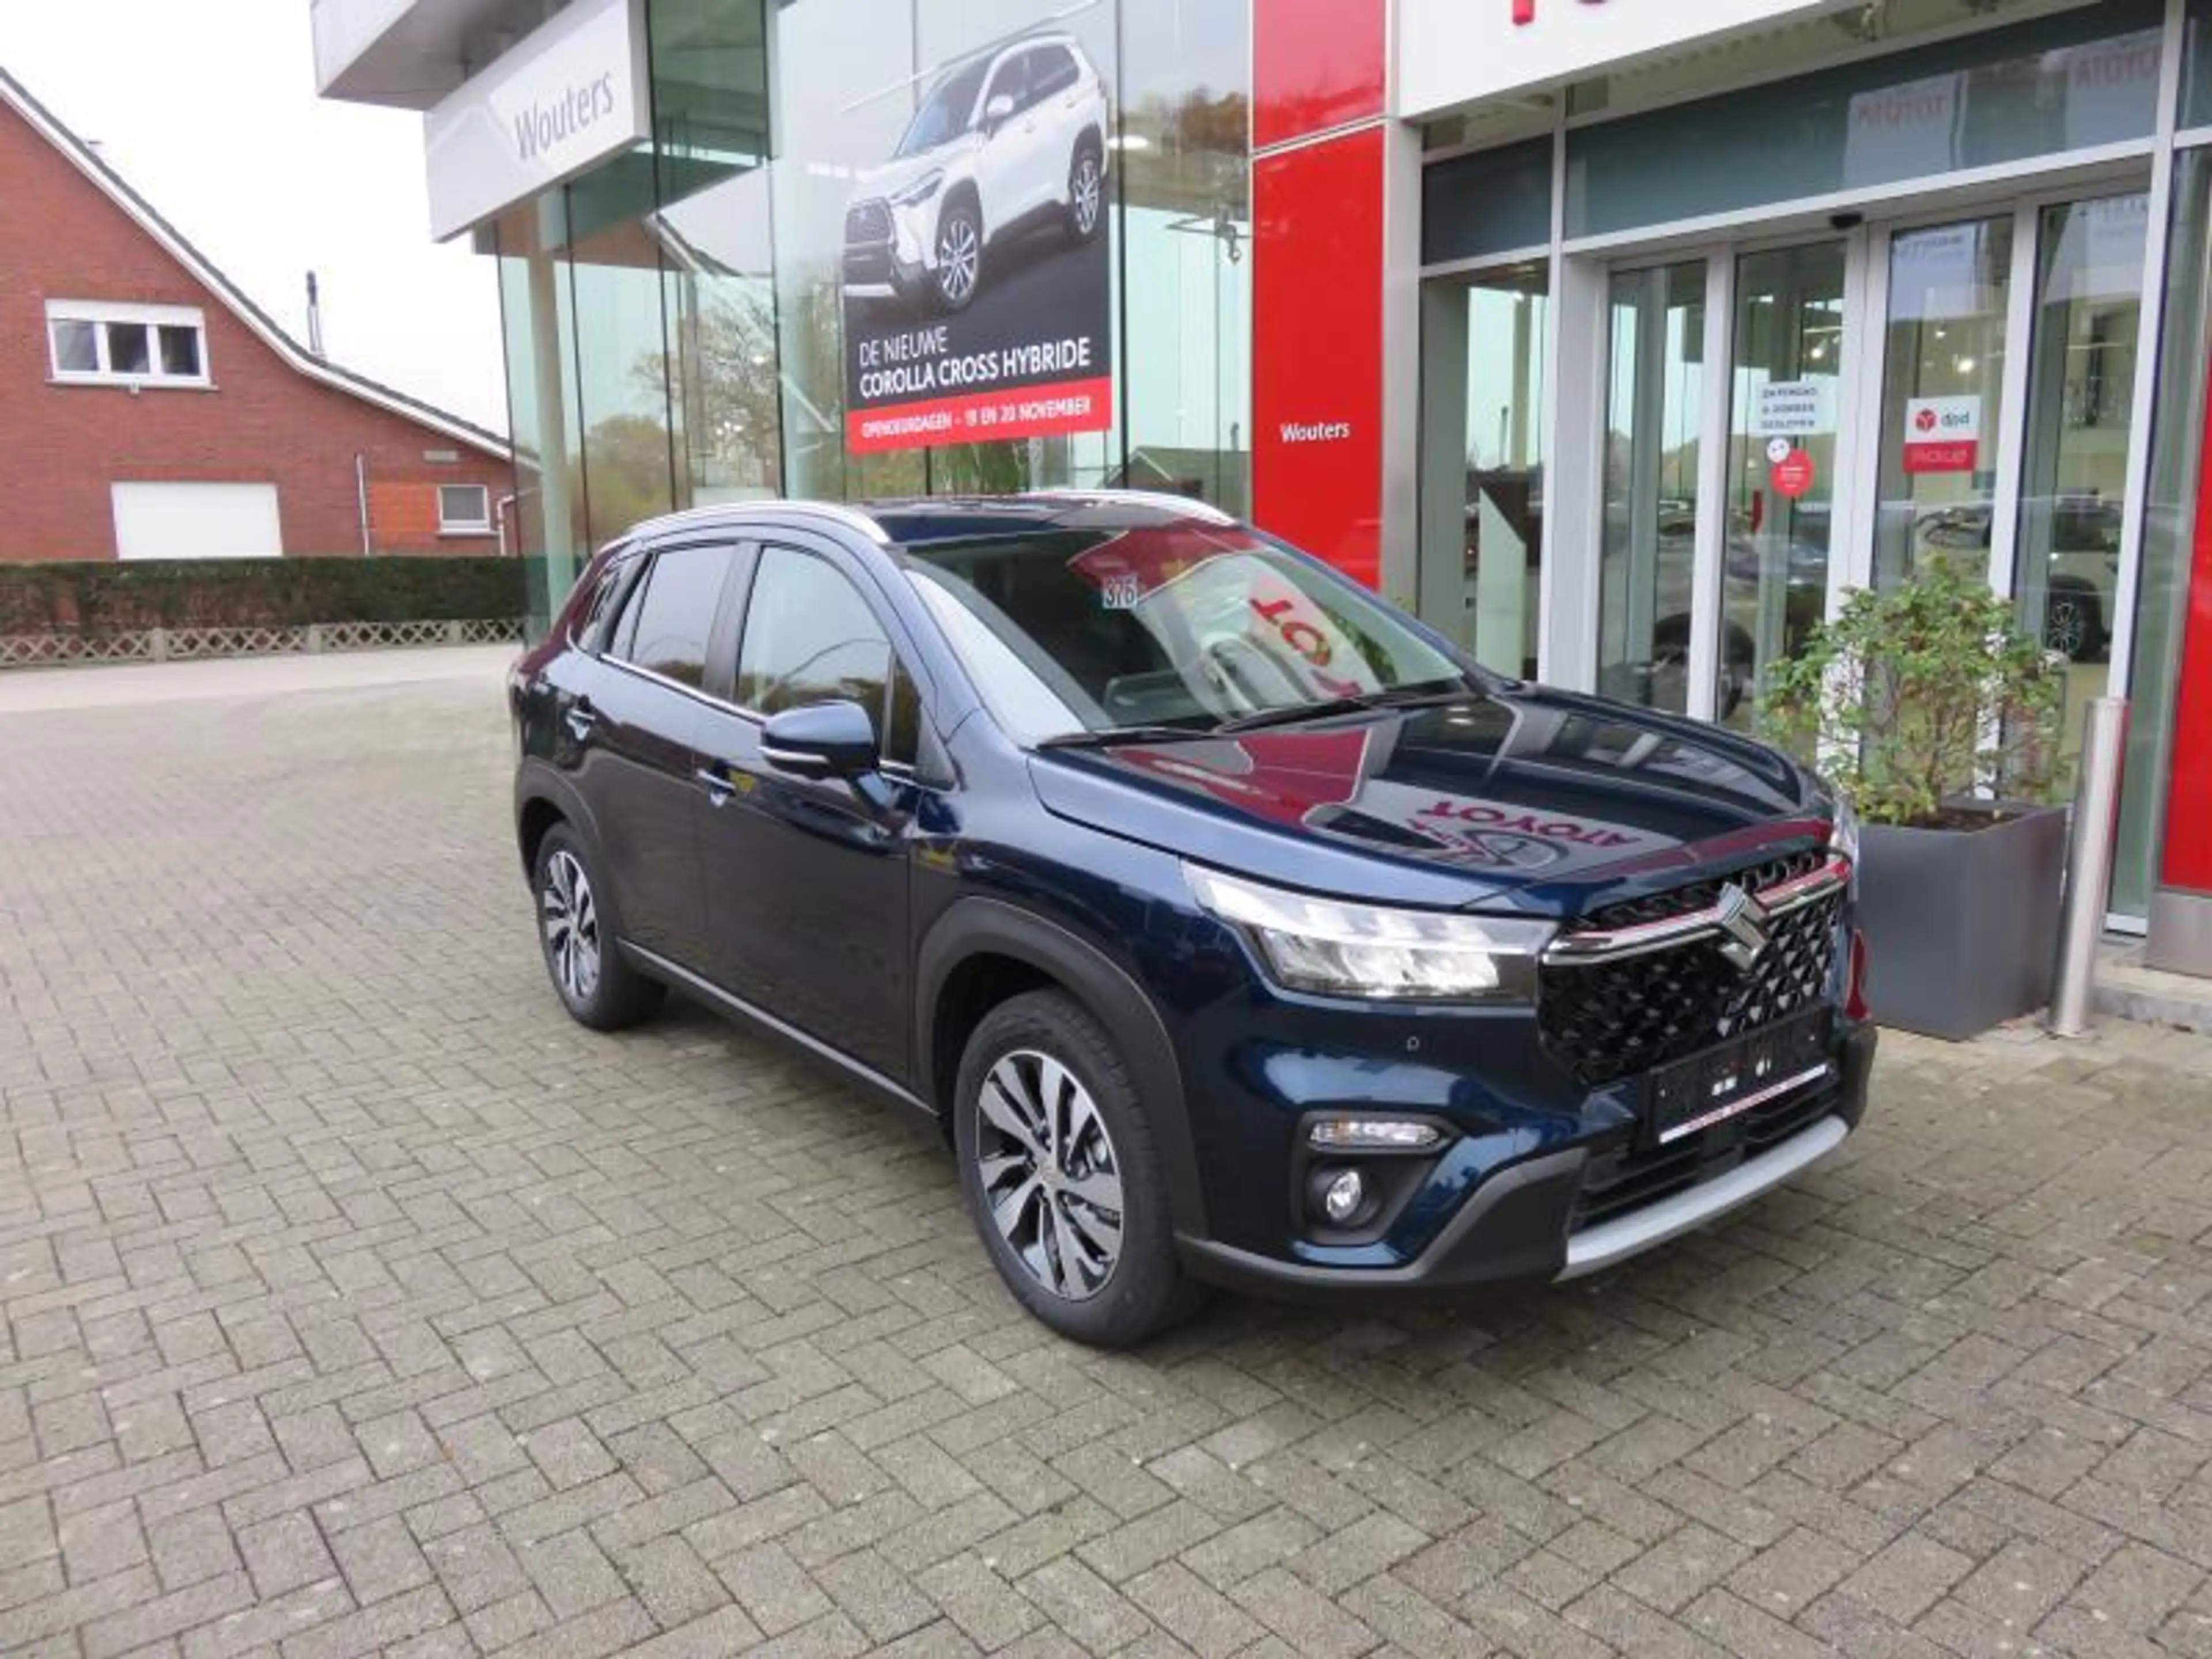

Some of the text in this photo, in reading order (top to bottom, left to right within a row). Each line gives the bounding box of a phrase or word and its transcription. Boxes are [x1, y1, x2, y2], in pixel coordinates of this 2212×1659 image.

[514, 71, 614, 160] Wouters
[859, 325, 948, 369] DE NIEUWE
[859, 336, 1092, 399] COROLLA CROSS HYBRIDE
[1018, 395, 1090, 421] NOVEMBER
[1280, 422, 1350, 442] Wouters
